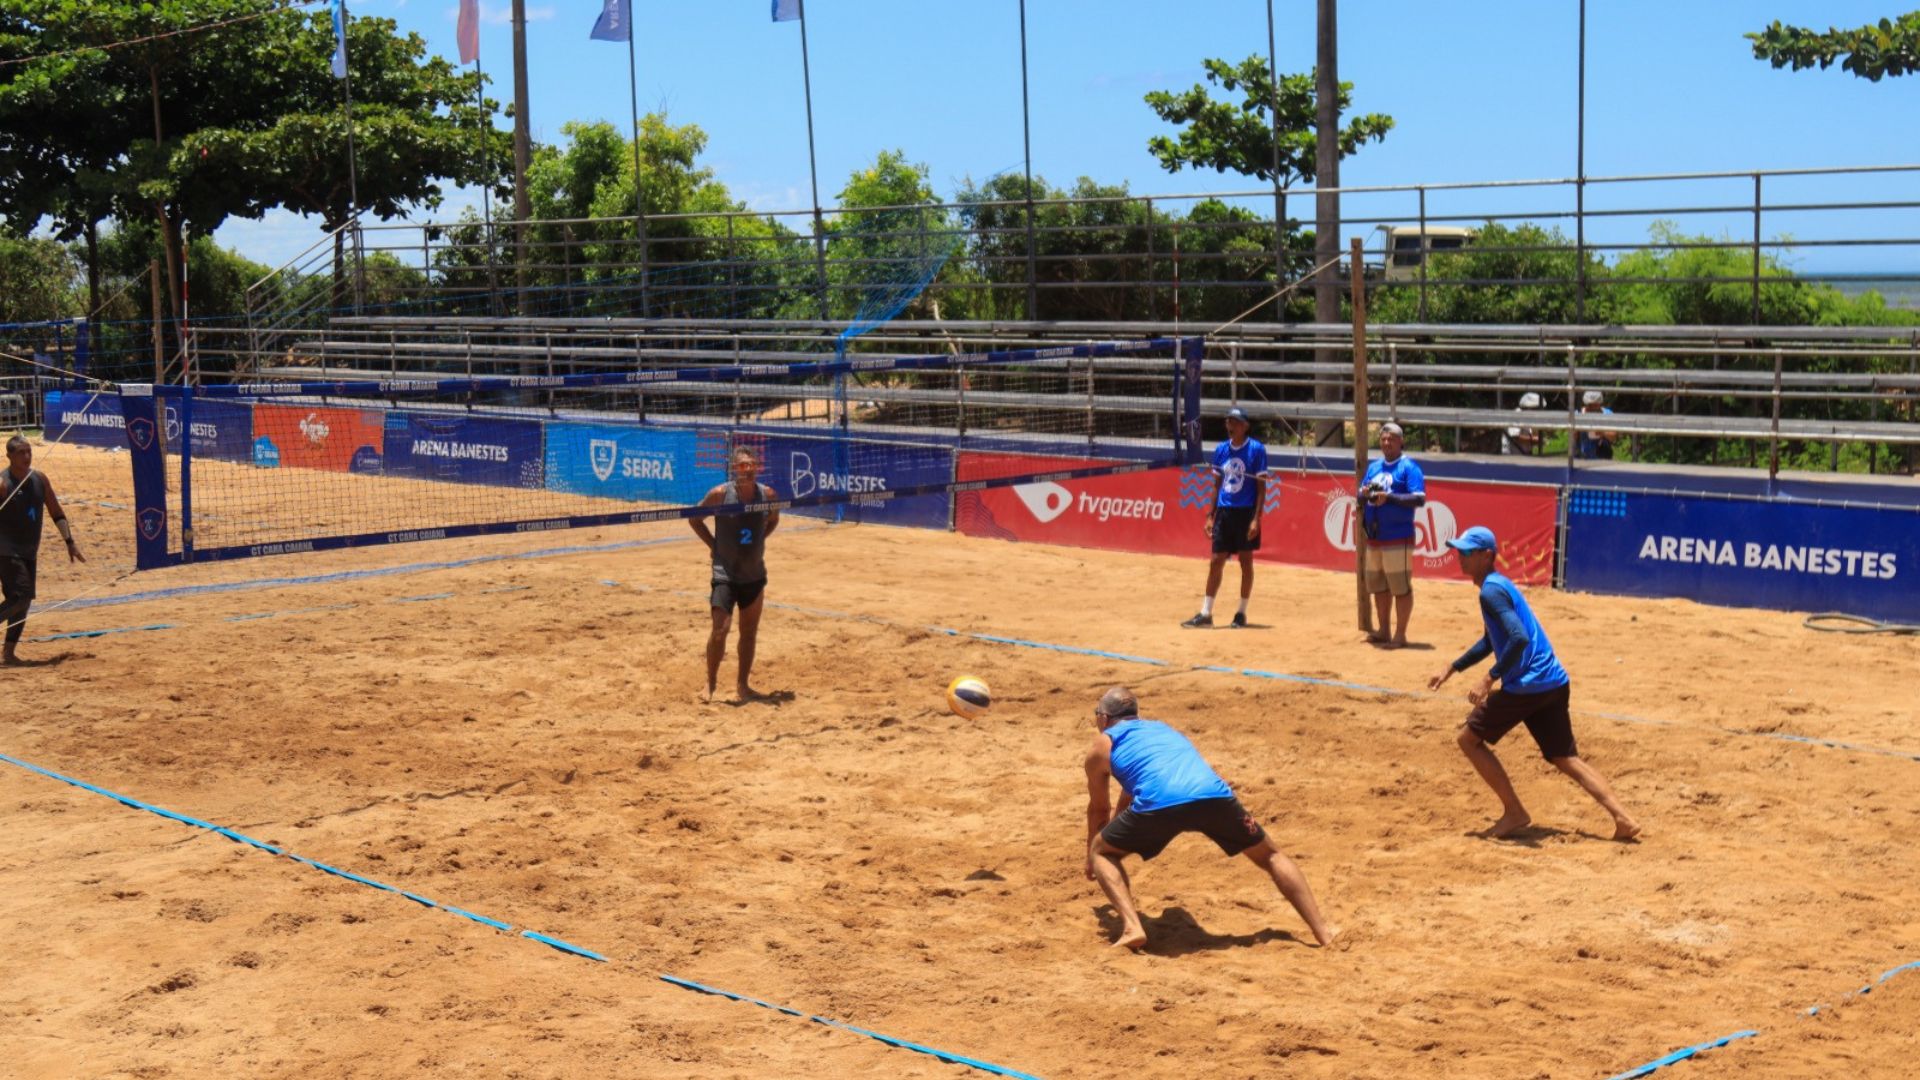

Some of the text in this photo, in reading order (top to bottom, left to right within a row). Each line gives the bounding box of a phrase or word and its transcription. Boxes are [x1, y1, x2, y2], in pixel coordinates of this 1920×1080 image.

[61, 411, 88, 425] ARENA
[412, 440, 508, 461] ARENA BANESTES
[622, 457, 674, 481] SERRA
[819, 472, 886, 494] BANESTES
[387, 529, 446, 543] CT CANA CAIANA
[740, 528, 752, 545] 2
[251, 542, 314, 556] CT CANA CAIANA
[1639, 535, 1897, 580] ARENA BANESTES
